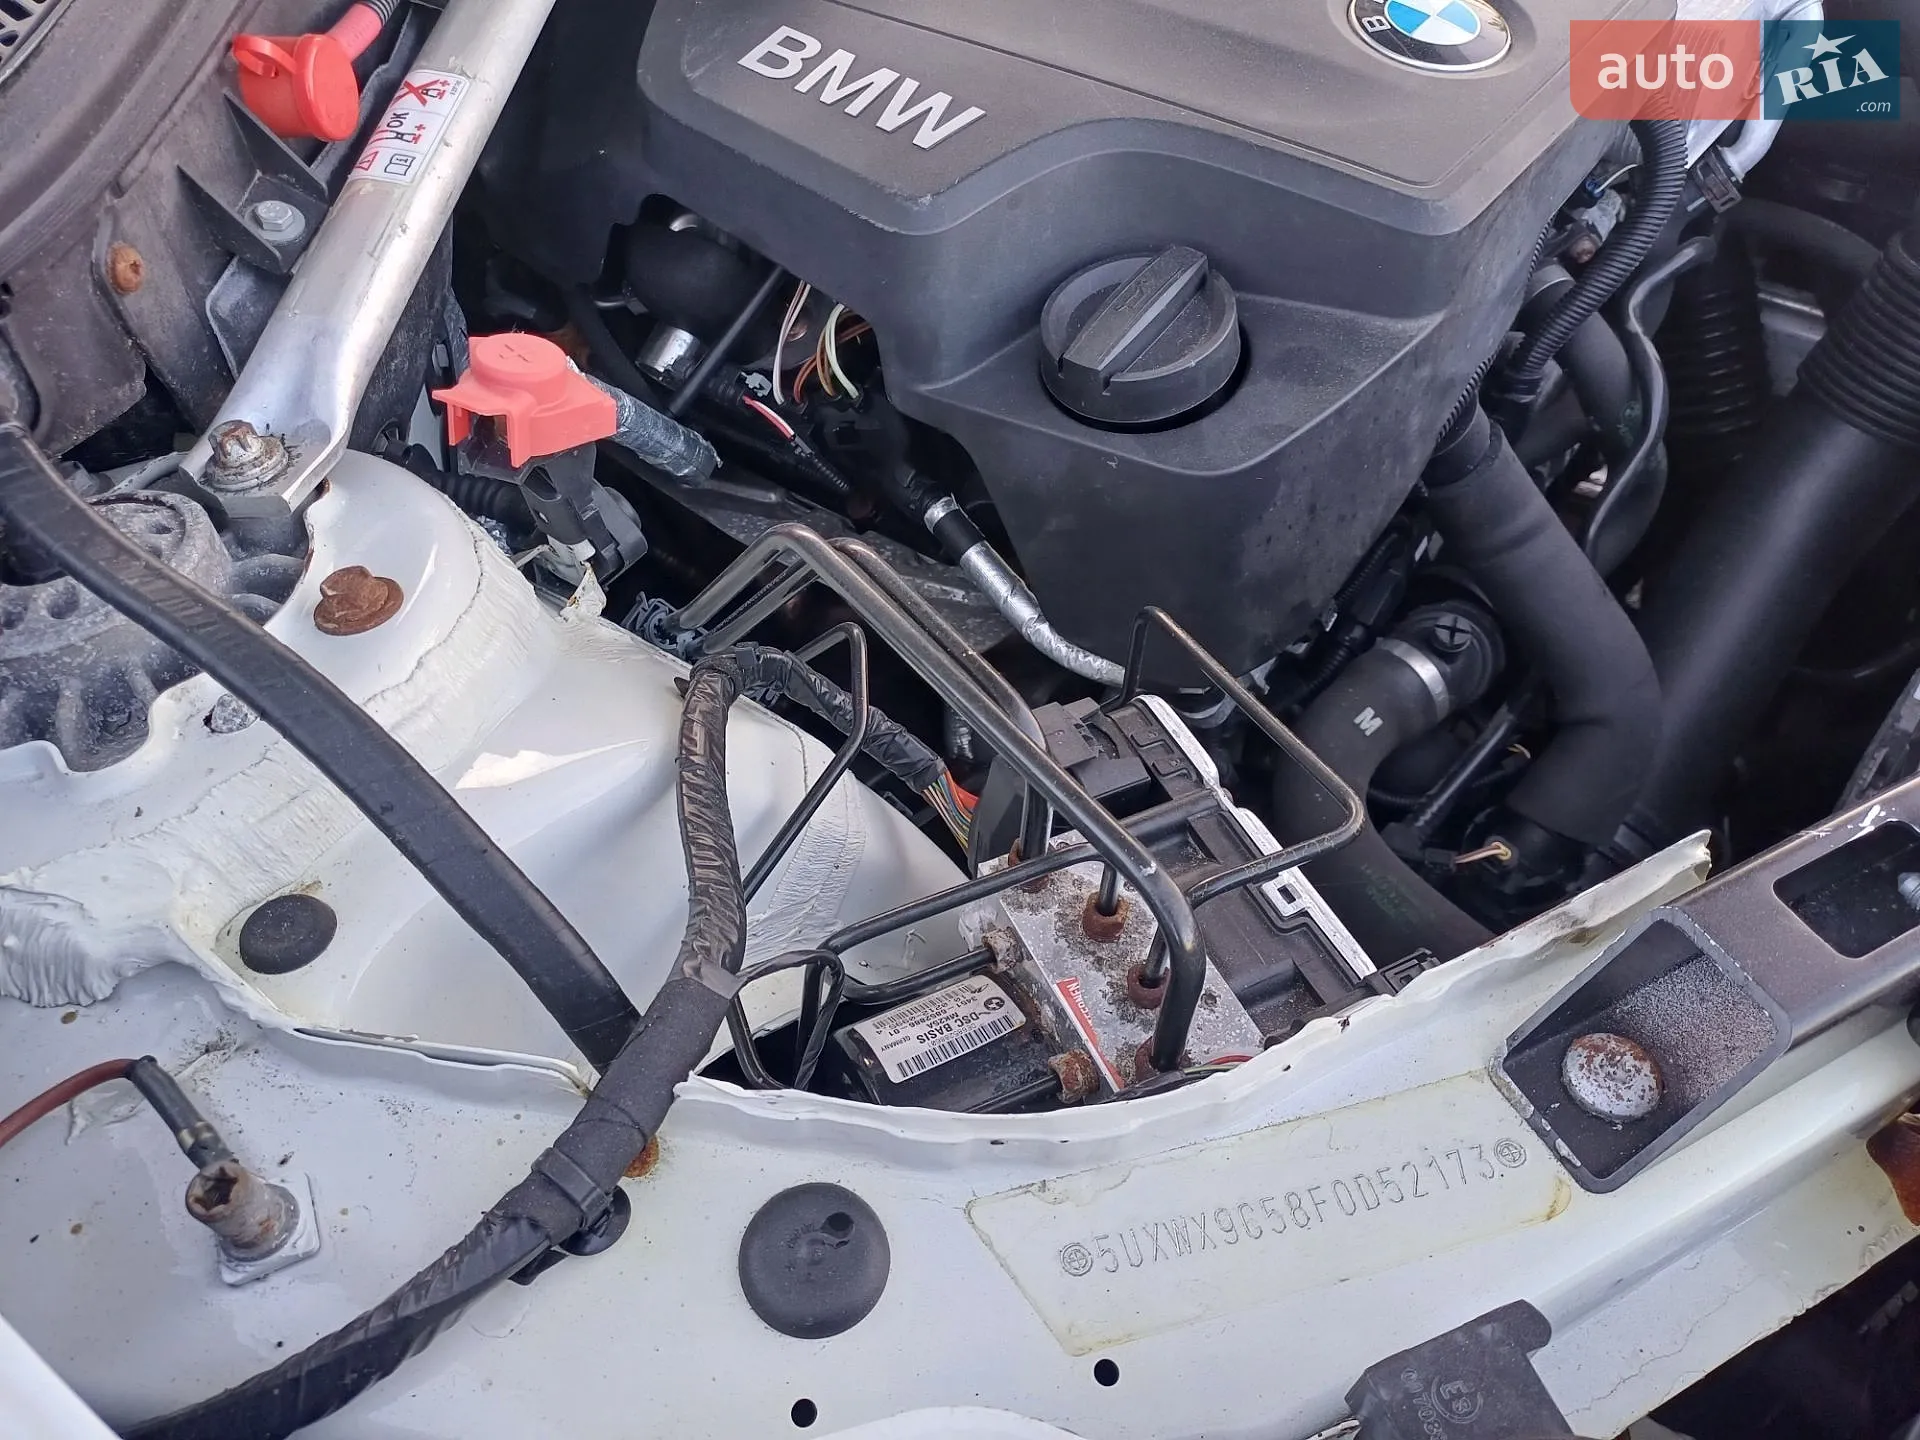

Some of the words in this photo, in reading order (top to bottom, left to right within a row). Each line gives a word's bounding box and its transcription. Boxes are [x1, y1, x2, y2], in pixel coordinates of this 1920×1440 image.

[737, 25, 987, 150] BMW
[386, 111, 410, 128] OK
[1353, 706, 1384, 737] M
[954, 1011, 980, 1028] DSC
[916, 1023, 953, 1044] BASIS
[881, 1035, 911, 1052] GERMANY
